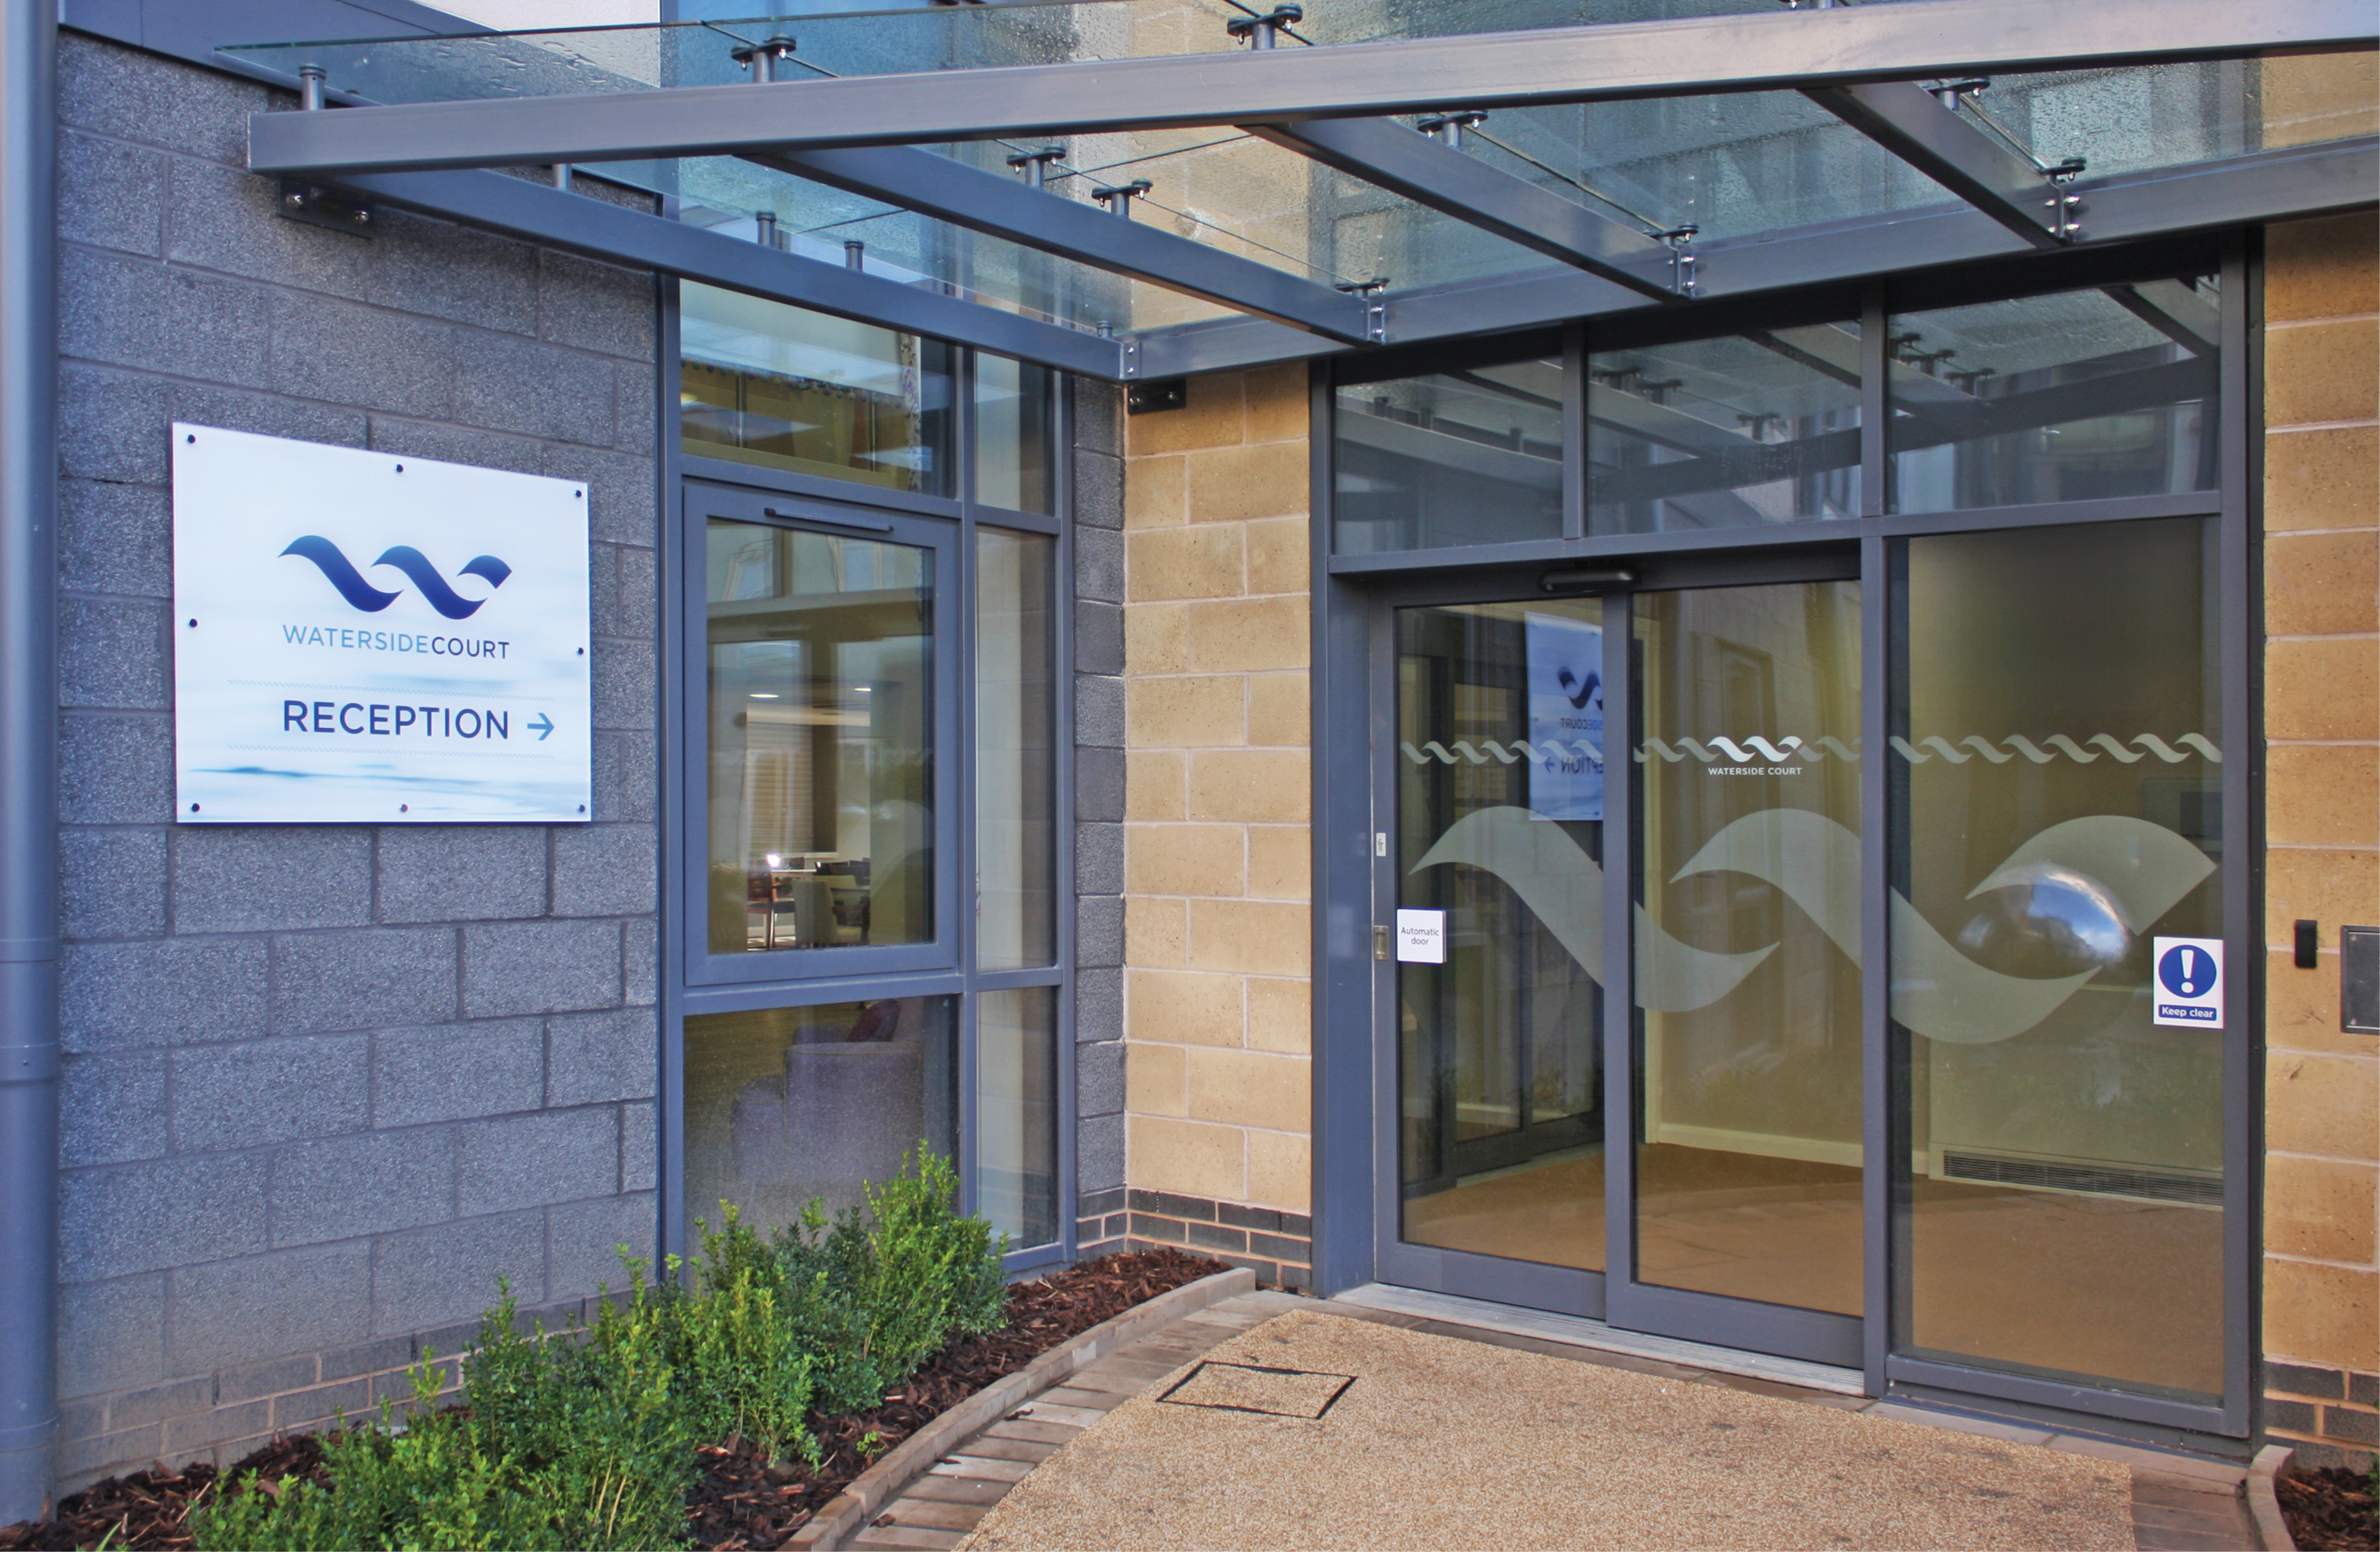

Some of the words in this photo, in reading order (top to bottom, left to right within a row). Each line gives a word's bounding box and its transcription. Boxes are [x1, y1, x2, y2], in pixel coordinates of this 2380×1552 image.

[282, 624, 510, 660] WATERSIDECOURT
[284, 700, 508, 739] RECEPTION
[1708, 767, 1764, 776] WATERSIDE
[1768, 767, 1802, 776] COURT
[1401, 927, 1439, 936] Automatic
[1410, 936, 1429, 945] door
[2162, 1006, 2186, 1017] Keep
[2189, 1008, 2214, 1018] clear
